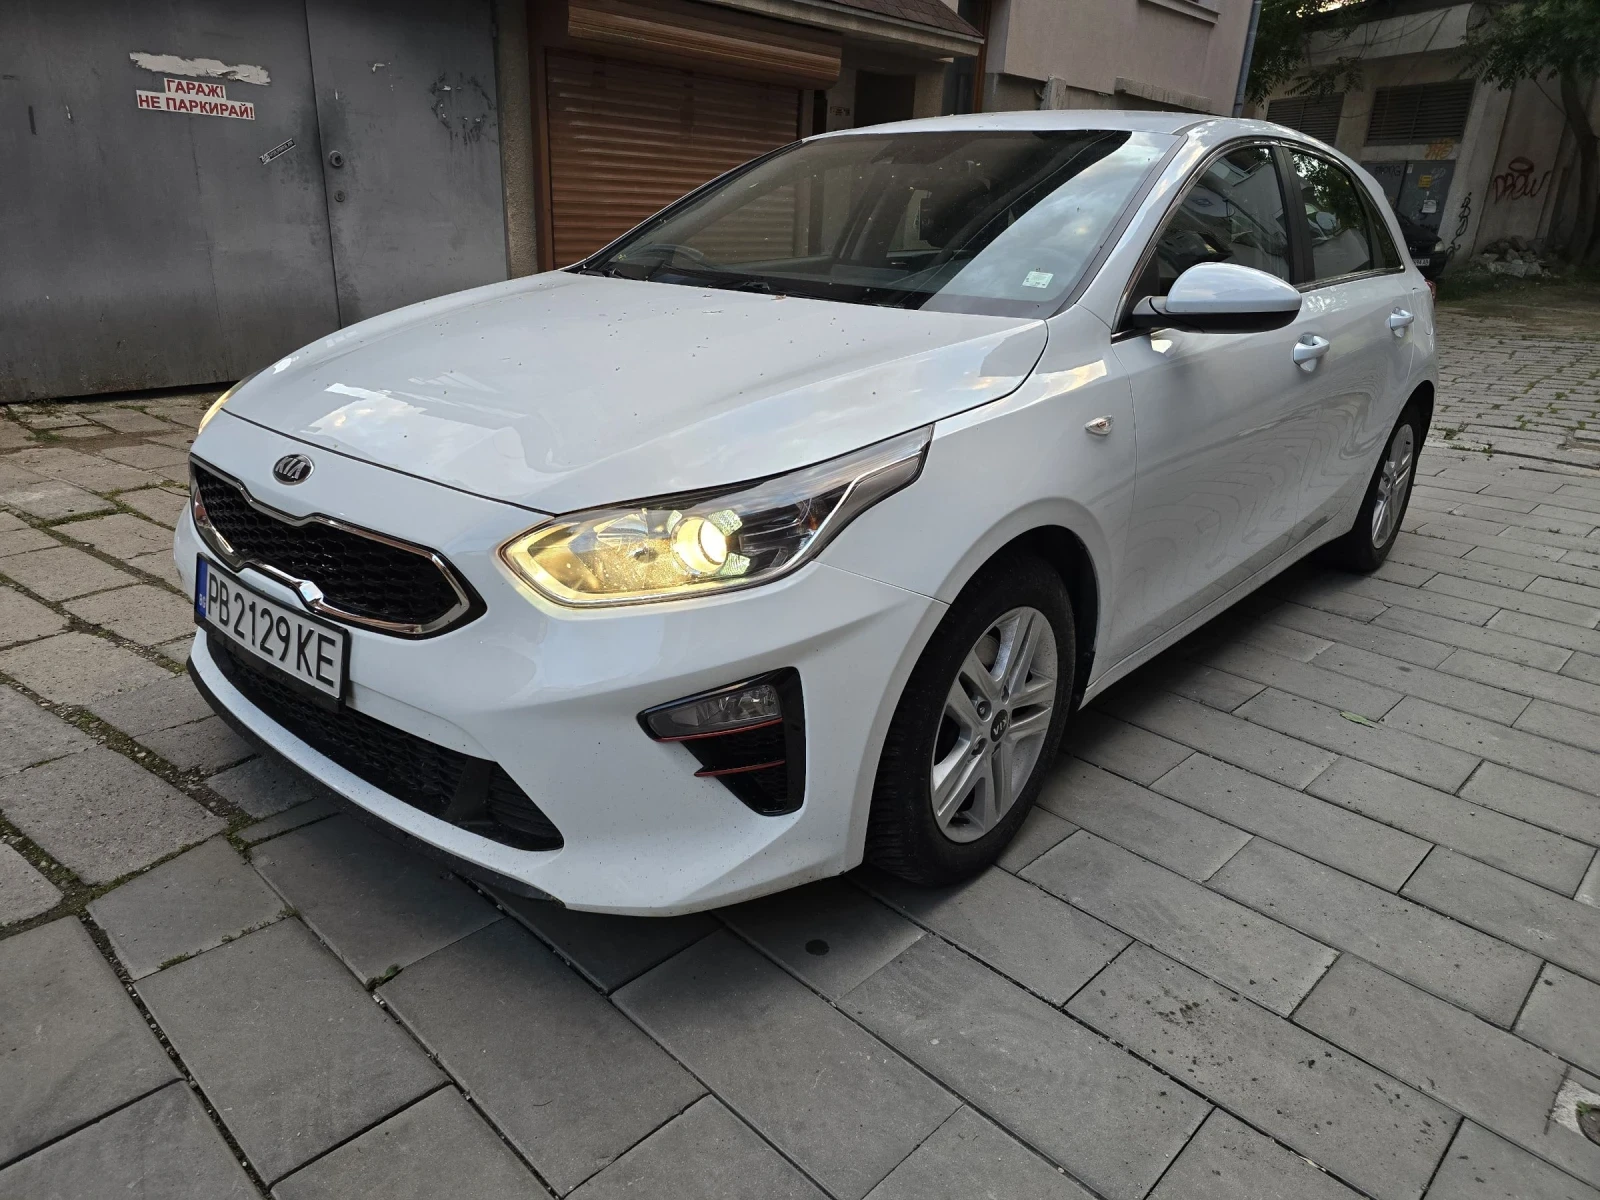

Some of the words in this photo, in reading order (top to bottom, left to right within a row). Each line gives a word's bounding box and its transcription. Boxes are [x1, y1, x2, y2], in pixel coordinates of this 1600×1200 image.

[166, 79, 225, 98] ГАРАЖ!
[138, 95, 161, 108] НЕ
[166, 97, 254, 119] ПАРКИРАЙ!
[275, 457, 306, 479] KIA
